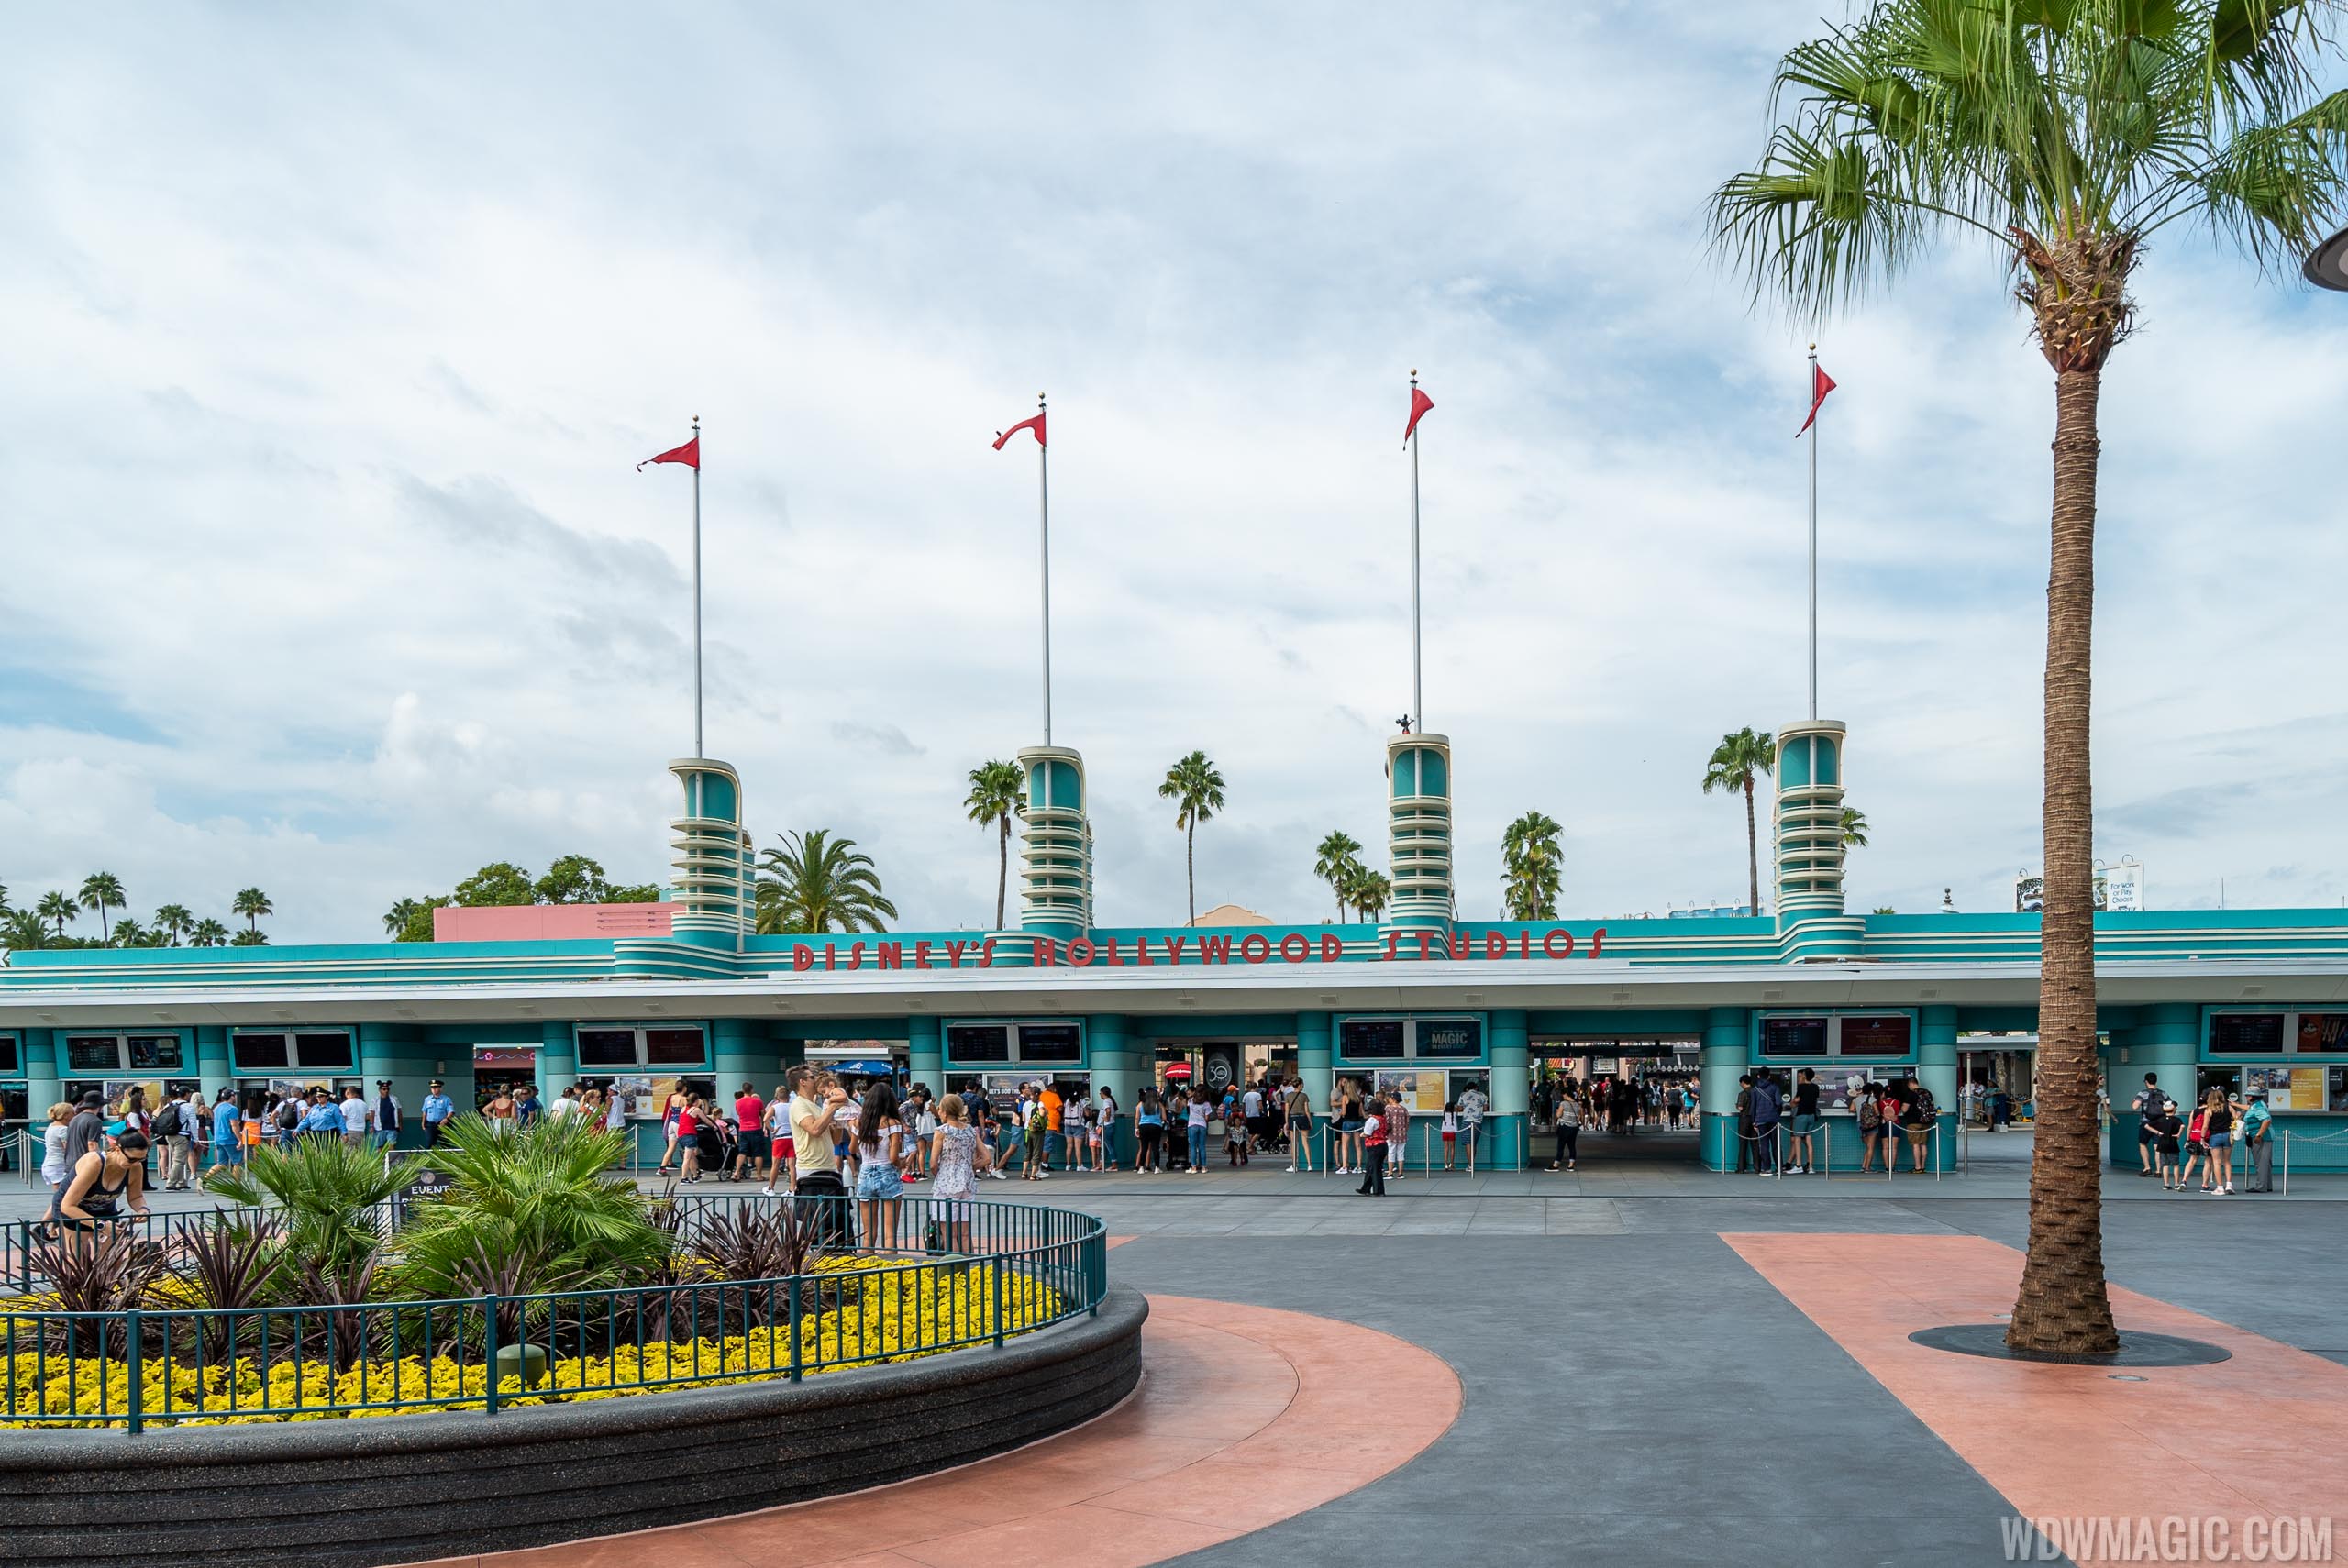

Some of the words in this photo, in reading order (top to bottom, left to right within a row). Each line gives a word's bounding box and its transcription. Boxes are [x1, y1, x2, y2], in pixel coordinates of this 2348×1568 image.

[793, 938, 998, 971] DISNEY'S
[1033, 933, 1343, 968] HOLLYWOOD
[1383, 927, 1608, 961] STUDIOS
[1432, 1033, 1468, 1044] MAGIC
[1209, 1066, 1228, 1082] 30
[411, 1185, 449, 1195] EVENT
